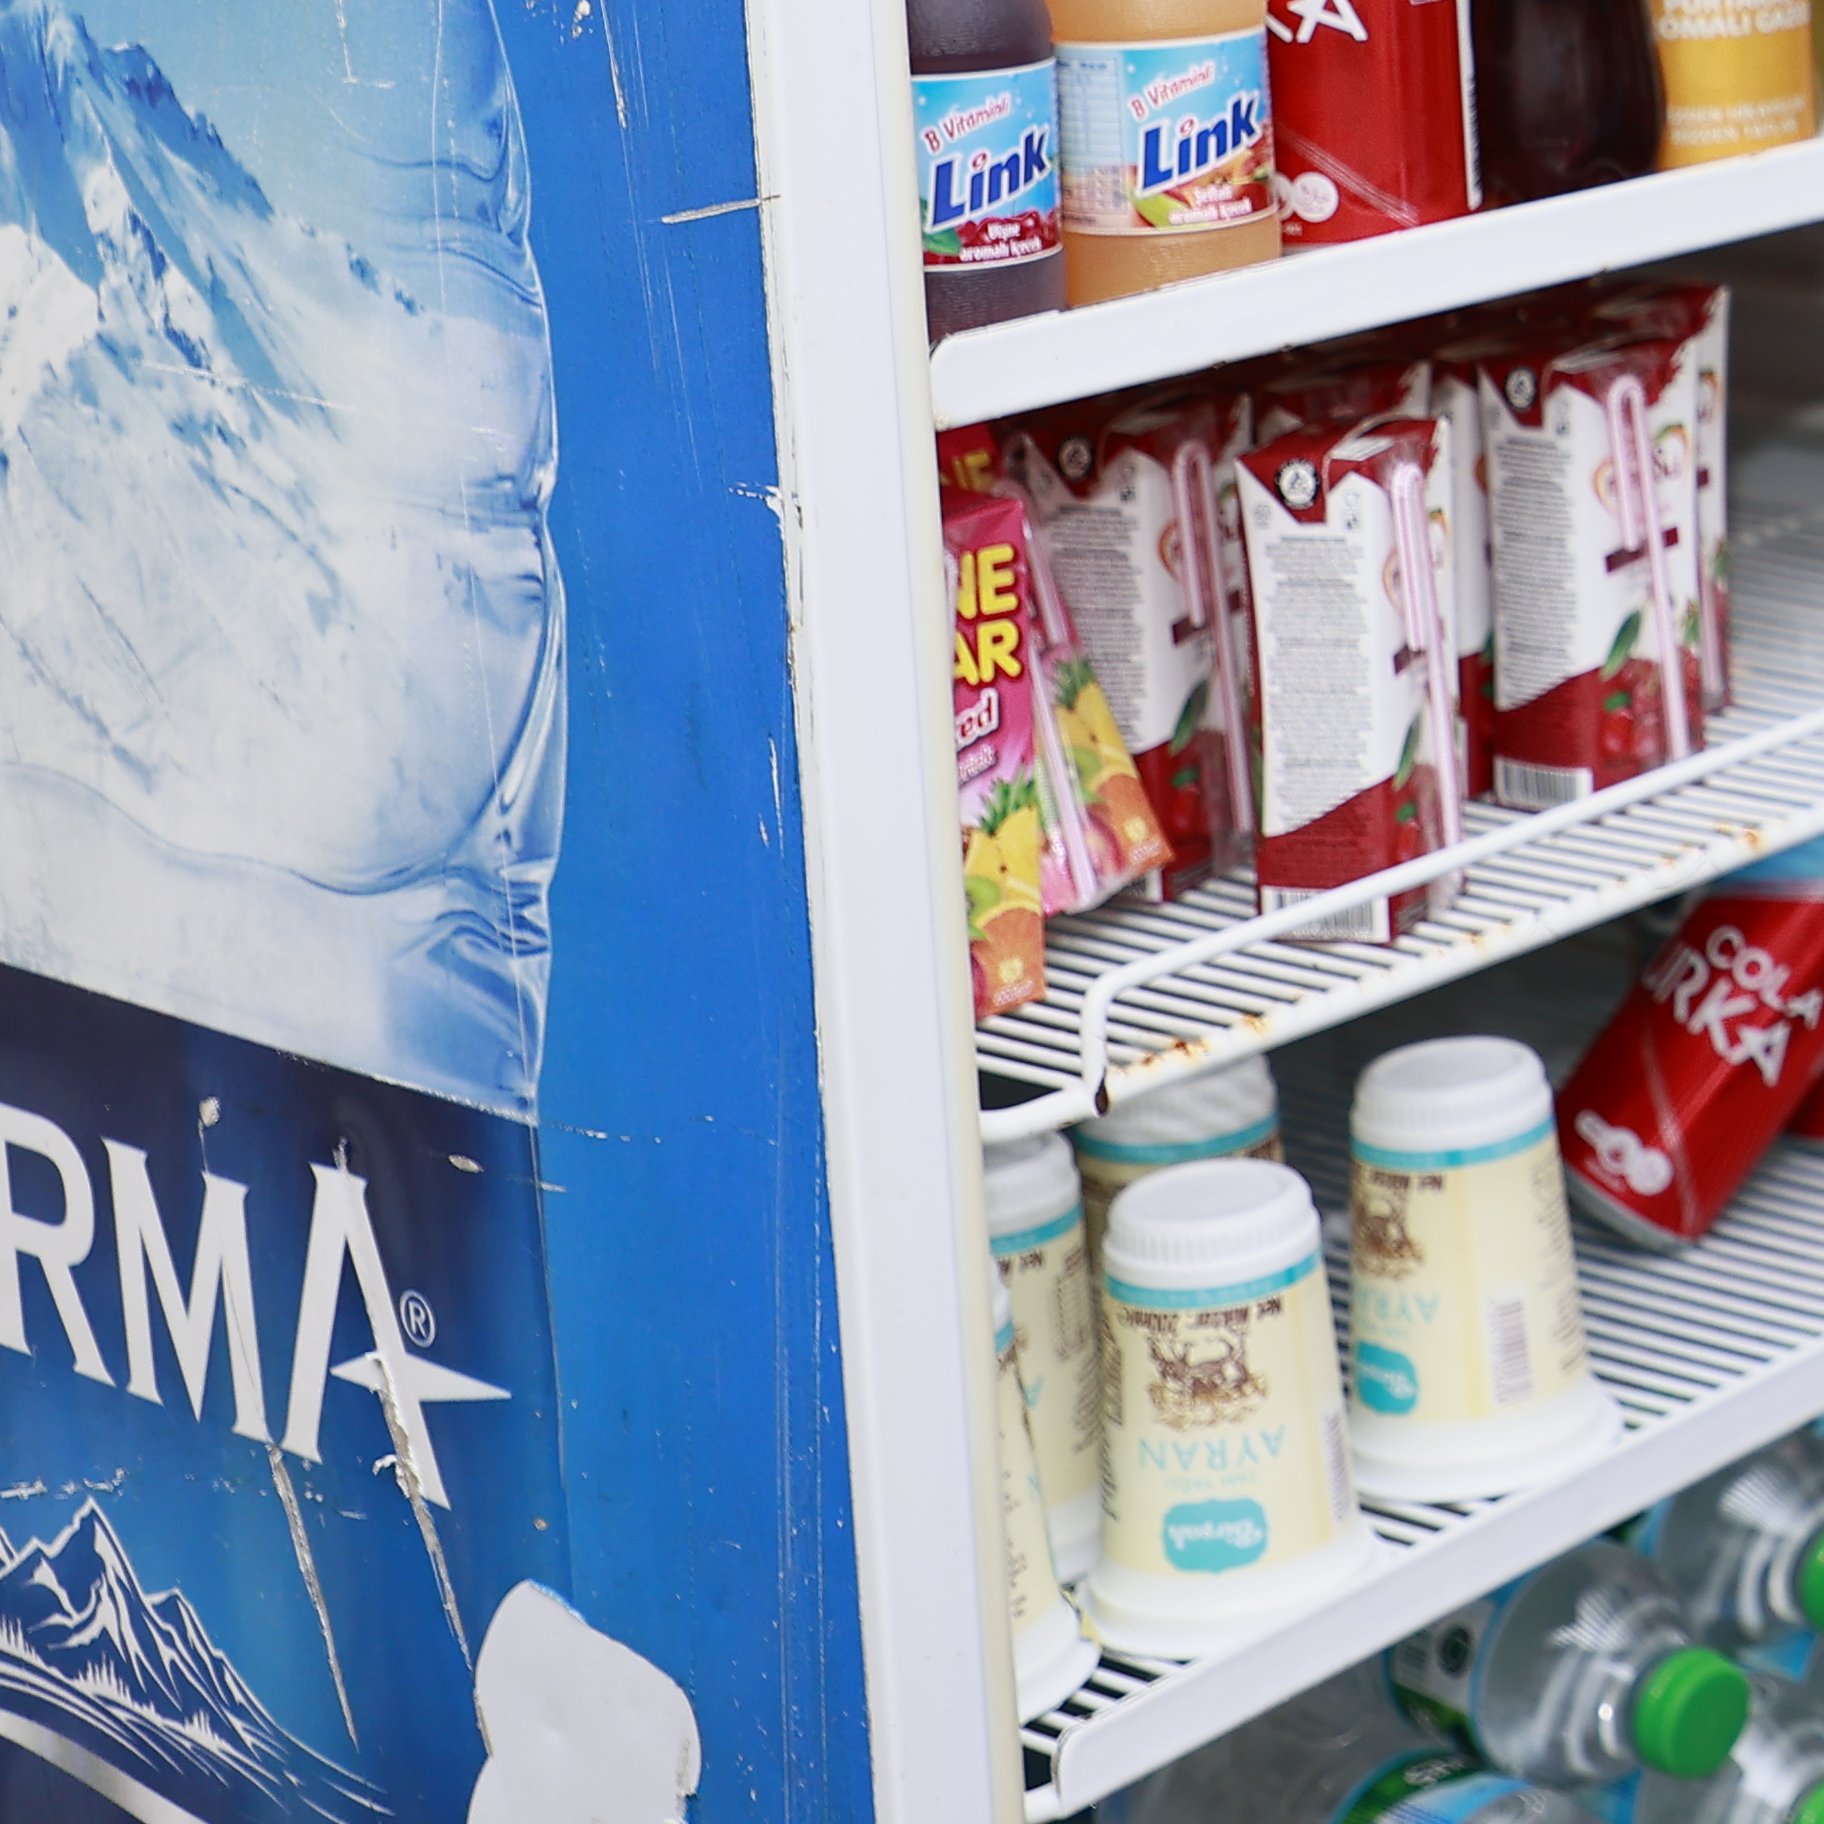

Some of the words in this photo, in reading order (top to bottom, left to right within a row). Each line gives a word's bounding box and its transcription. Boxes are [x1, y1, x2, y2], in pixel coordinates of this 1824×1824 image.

[925, 132, 940, 152] B
[933, 131, 1046, 226] Link
[1142, 99, 1256, 190] Link
[1705, 925, 1824, 1030] COLA
[1139, 1424, 1286, 1472] AYRAN
